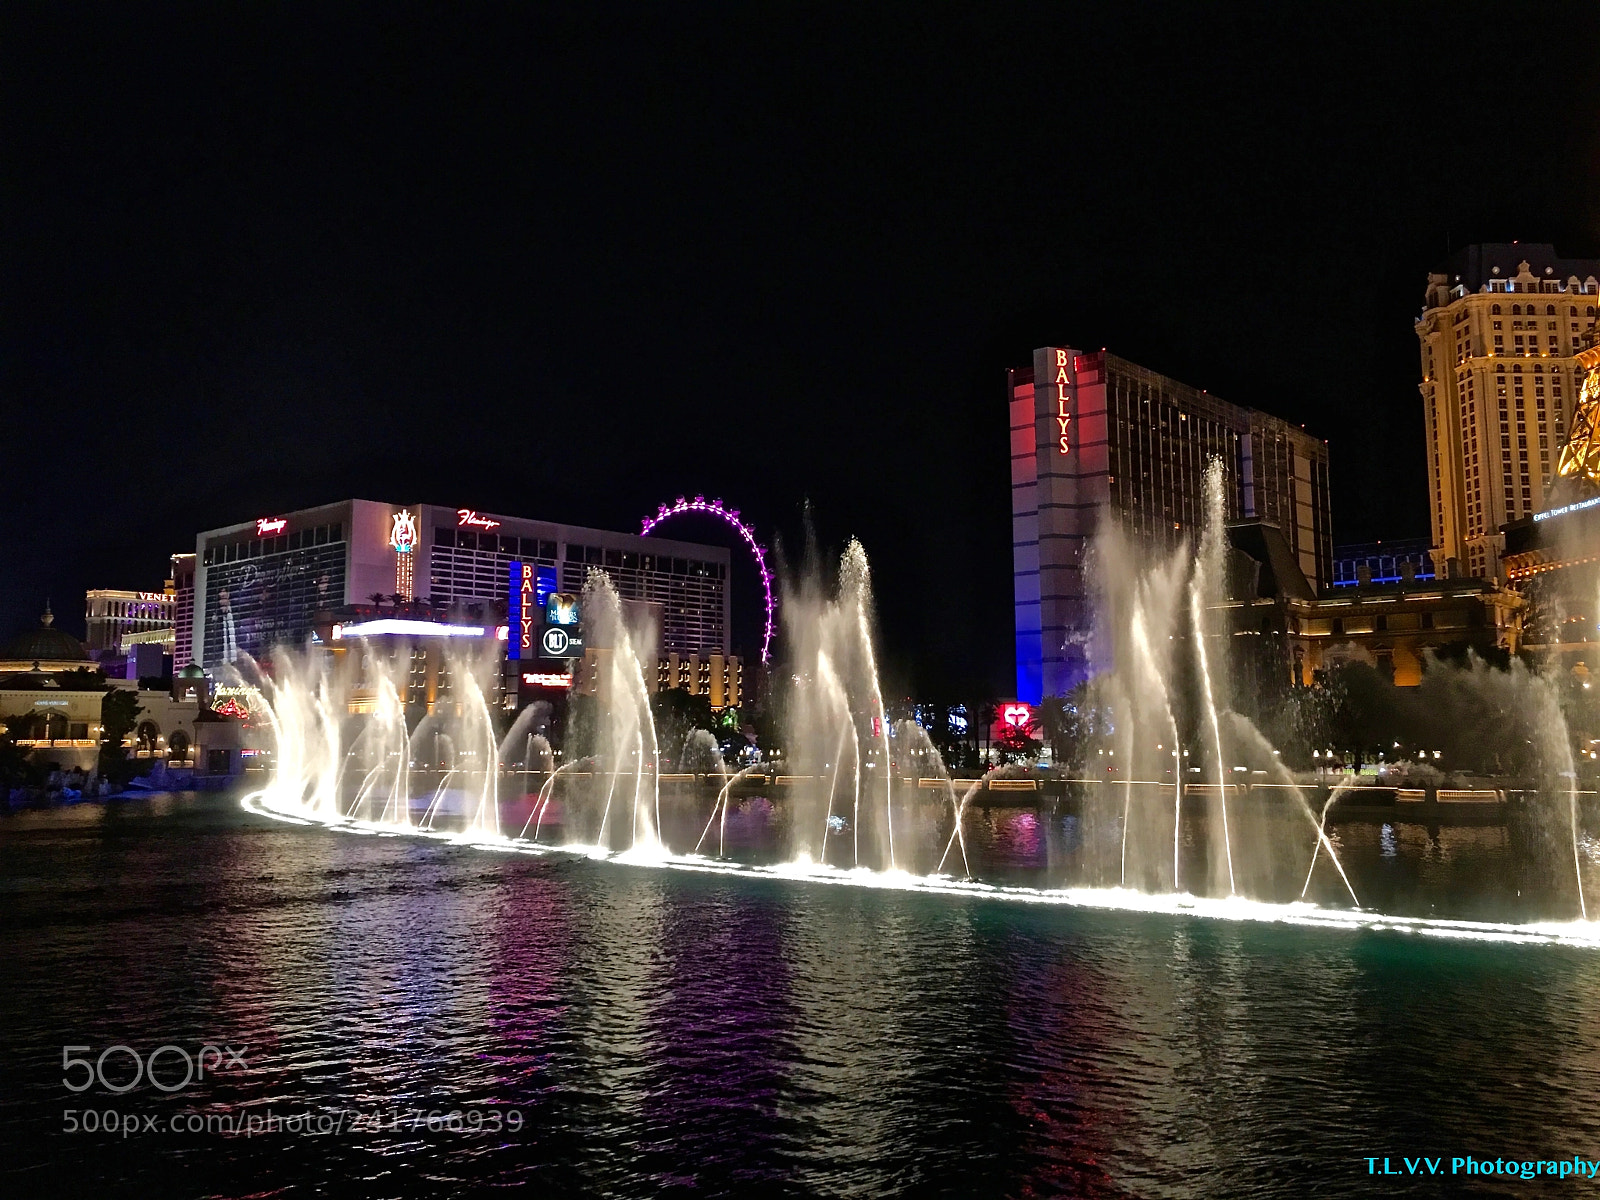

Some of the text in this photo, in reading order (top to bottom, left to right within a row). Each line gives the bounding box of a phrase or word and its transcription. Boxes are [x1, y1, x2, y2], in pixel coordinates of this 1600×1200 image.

[1055, 349, 1071, 454] BALLYS
[138, 591, 177, 602] VENET
[520, 565, 533, 648] BALLYS
